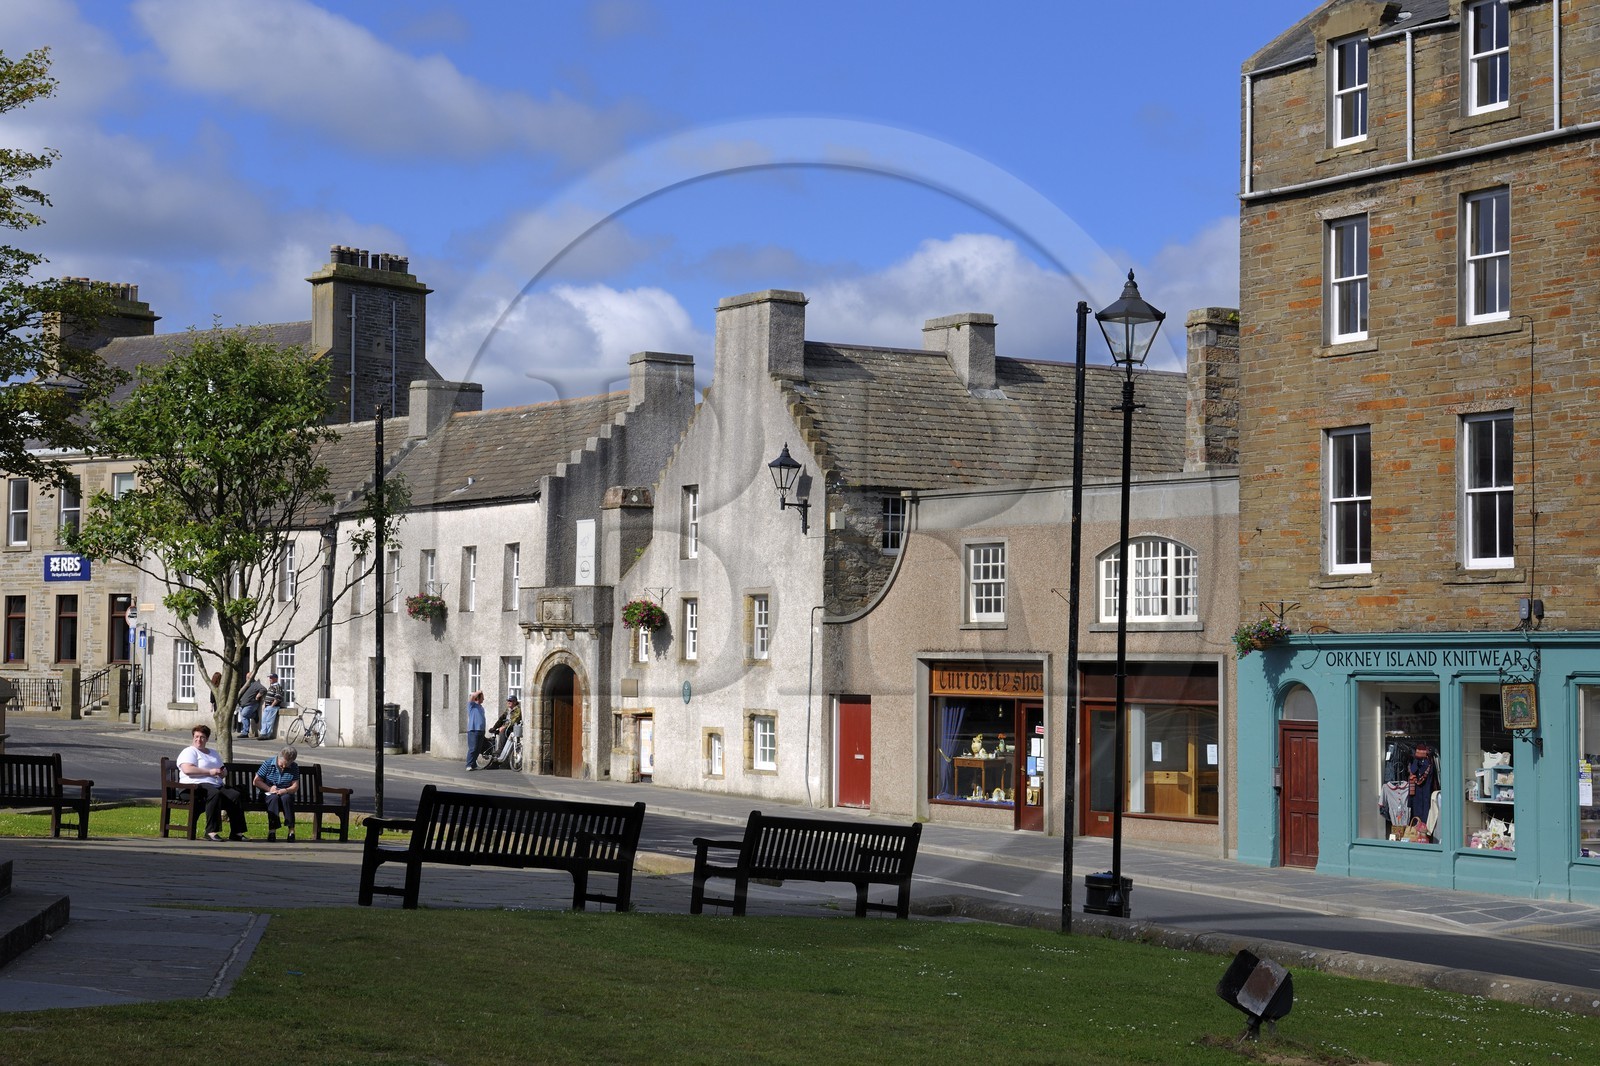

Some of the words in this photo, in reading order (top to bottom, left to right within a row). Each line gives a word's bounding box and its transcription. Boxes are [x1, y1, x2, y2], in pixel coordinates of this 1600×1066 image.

[61, 557, 81, 572] RBS
[1325, 651, 1381, 667] ORKNEY
[1386, 651, 1437, 667] ISLAND
[1443, 650, 1522, 667] KNITWEAR
[939, 669, 1010, 691] Curiosity
